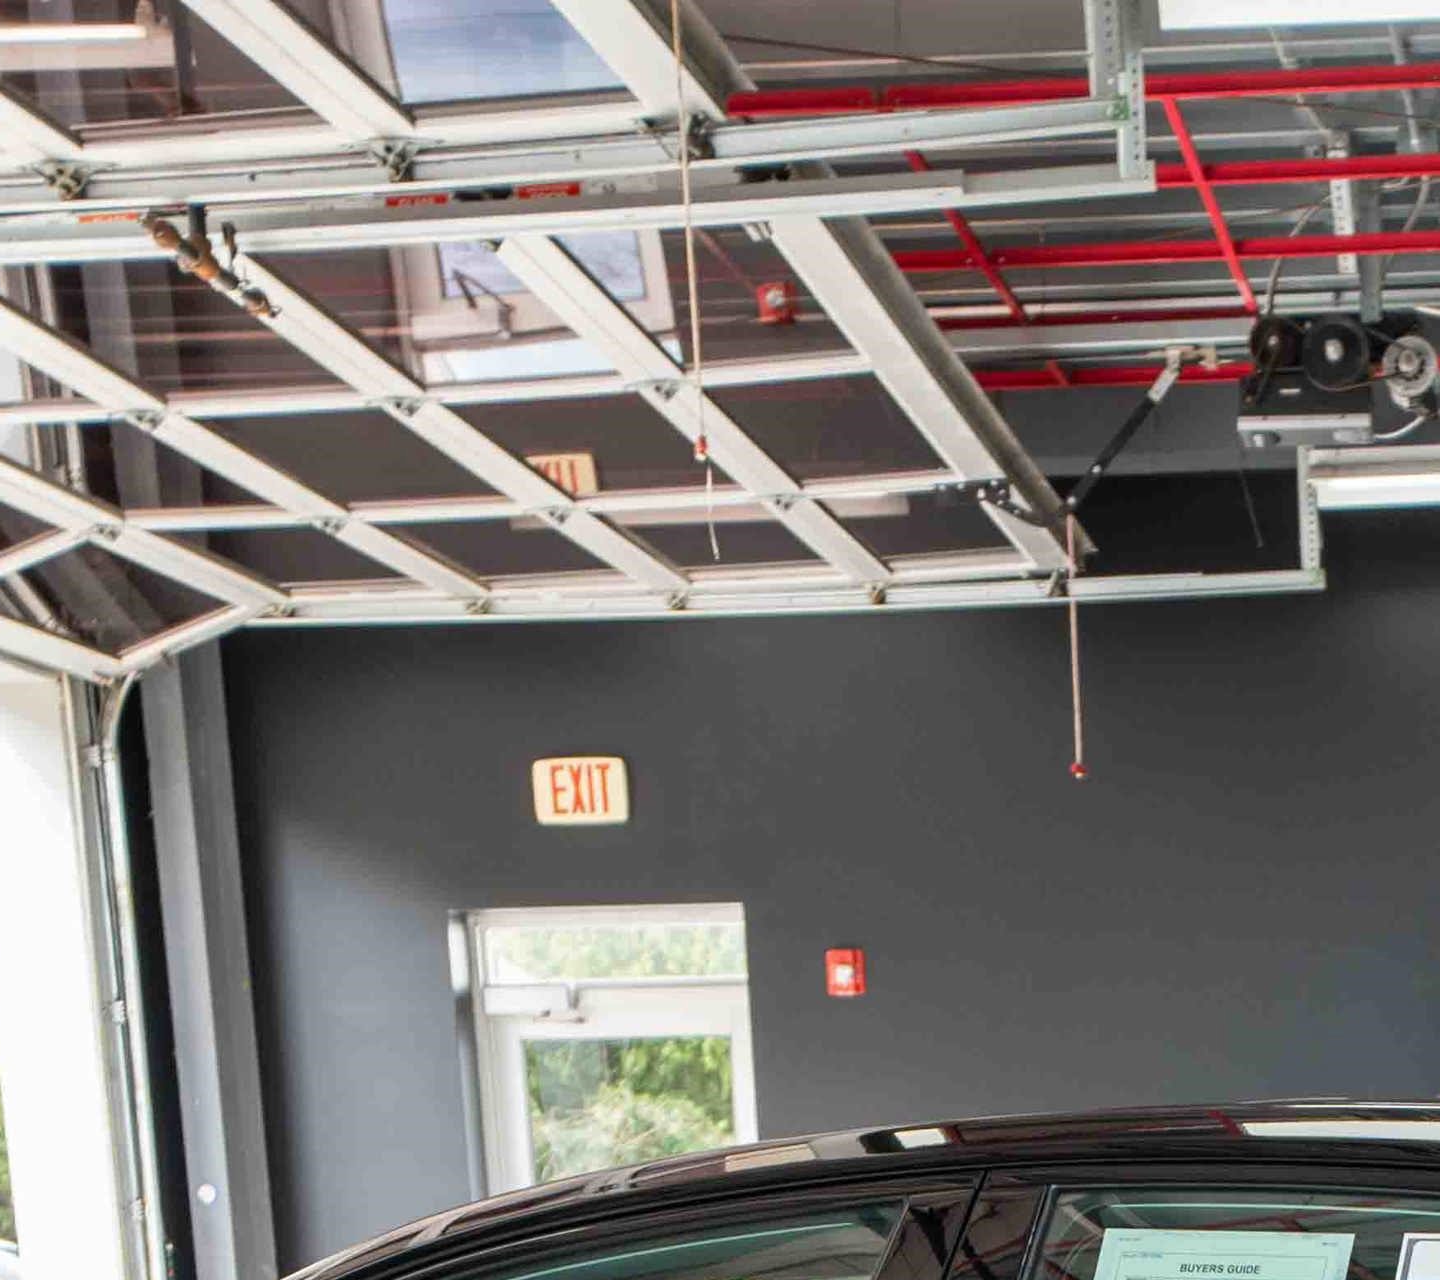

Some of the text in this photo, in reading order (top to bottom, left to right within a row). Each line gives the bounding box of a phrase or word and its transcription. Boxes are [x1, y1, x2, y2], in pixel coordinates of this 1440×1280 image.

[550, 763, 610, 815] EXIT
[1179, 1263, 1261, 1275] BUYERS GUIDE
